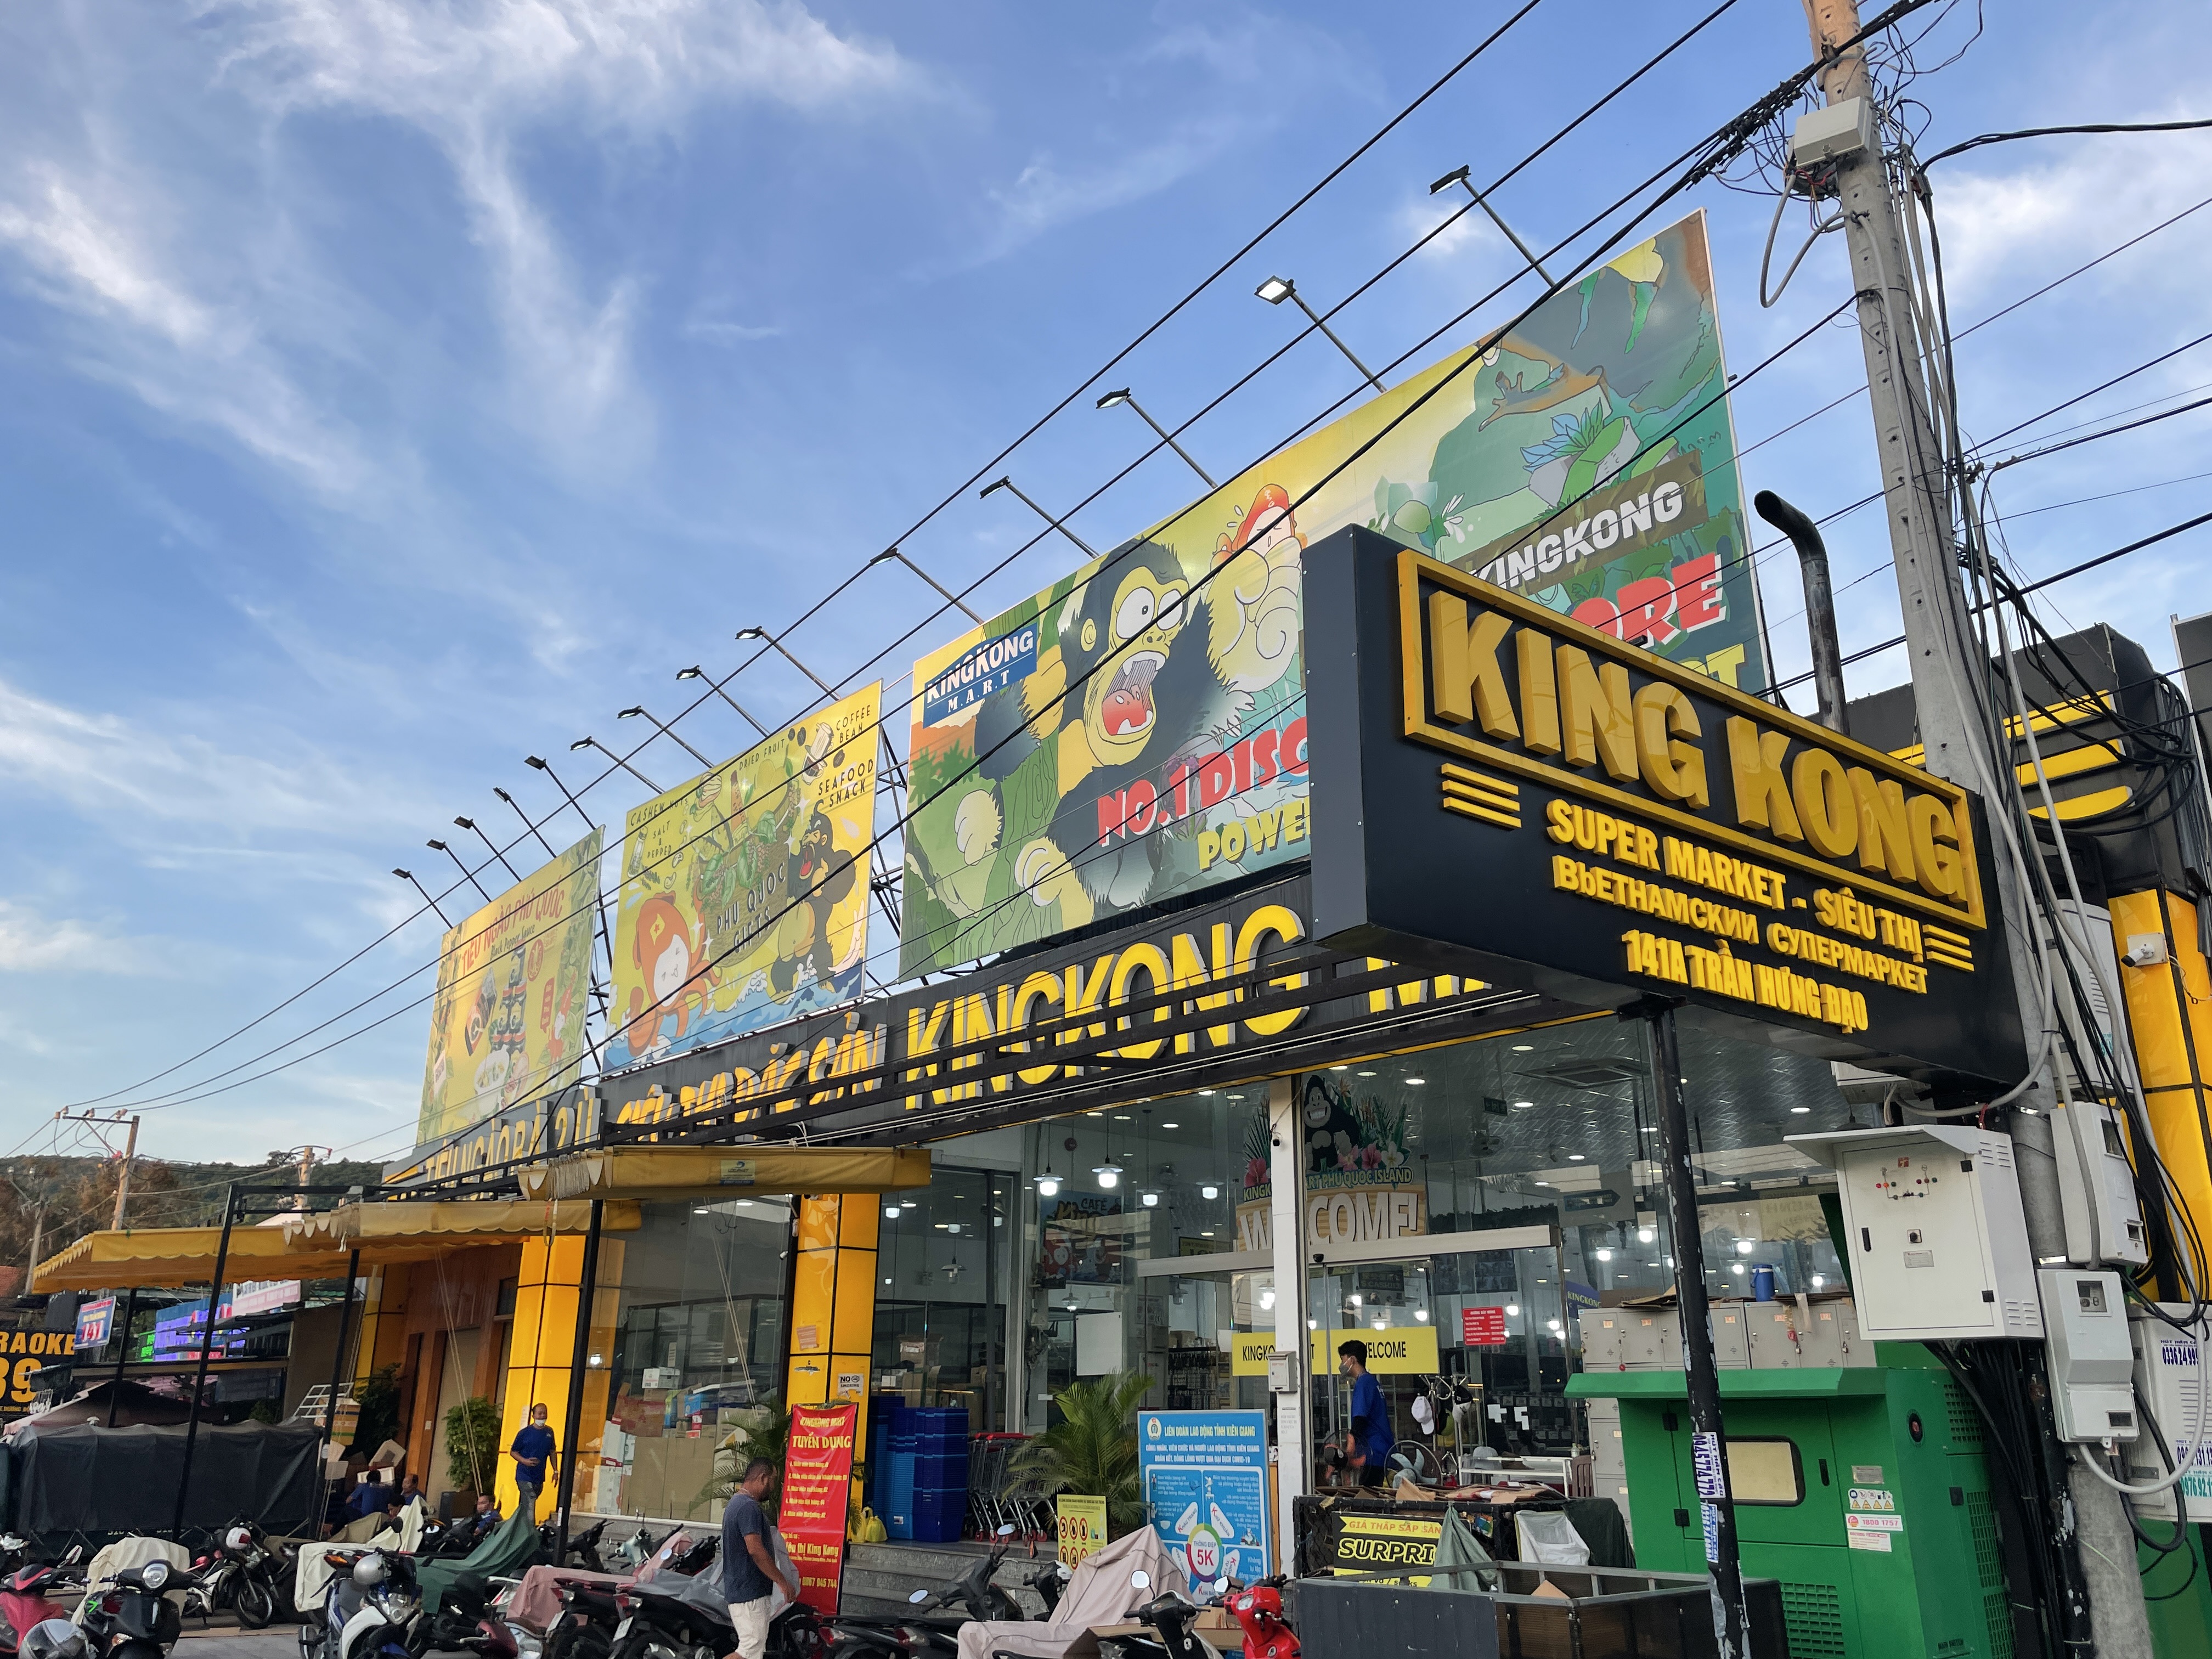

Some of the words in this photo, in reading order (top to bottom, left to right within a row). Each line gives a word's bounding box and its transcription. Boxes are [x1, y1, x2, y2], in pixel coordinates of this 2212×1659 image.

[927, 630, 1033, 704] KINGKONG
[836, 704, 871, 731] COFFEE
[839, 723, 864, 743] BEAN
[1429, 591, 1709, 809] KING
[1726, 714, 1967, 902] KONG
[739, 753, 760, 771] DRIED
[764, 738, 785, 757] FRUIT
[818, 759, 874, 795] SEAFOOD
[829, 782, 866, 808] SNACK
[1098, 763, 1199, 848] NO.1
[631, 802, 665, 826] CASHEW
[653, 820, 670, 839] SALT
[1198, 797, 1311, 872] POWE
[647, 845, 672, 858] PEPPER
[1547, 799, 1661, 871] SUPER
[1663, 836, 1786, 910] MARKET
[1813, 887, 1876, 940] SIÊU
[1875, 908, 1923, 963] THỊ
[718, 901, 739, 934] PHU
[747, 862, 786, 913] QUOC
[733, 906, 770, 953] GIFTS
[1767, 923, 1927, 994] СУПЕРМАРКЕТ
[1621, 929, 1688, 984] 141A
[1685, 939, 1755, 1002] TRẦN
[1753, 964, 1822, 1019] HƯNG
[1820, 983, 1868, 1034] ĐẠO
[905, 905, 1309, 1109] KINGKONG
[1322, 1172, 1343, 1188] PHU
[1344, 1170, 1374, 1189] QUOC
[1374, 1167, 1412, 1184] ISLAND
[793, 1431, 820, 1448] TUYỂN
[822, 1435, 851, 1451] DỤNG
[1350, 1520, 1367, 1530] GIÁ
[1371, 1520, 1396, 1531] THẤP
[807, 1543, 822, 1556] King
[823, 1544, 839, 1557] Kong
[1197, 1549, 1214, 1566] 5K
[1338, 1538, 1436, 1565] SURPRI
